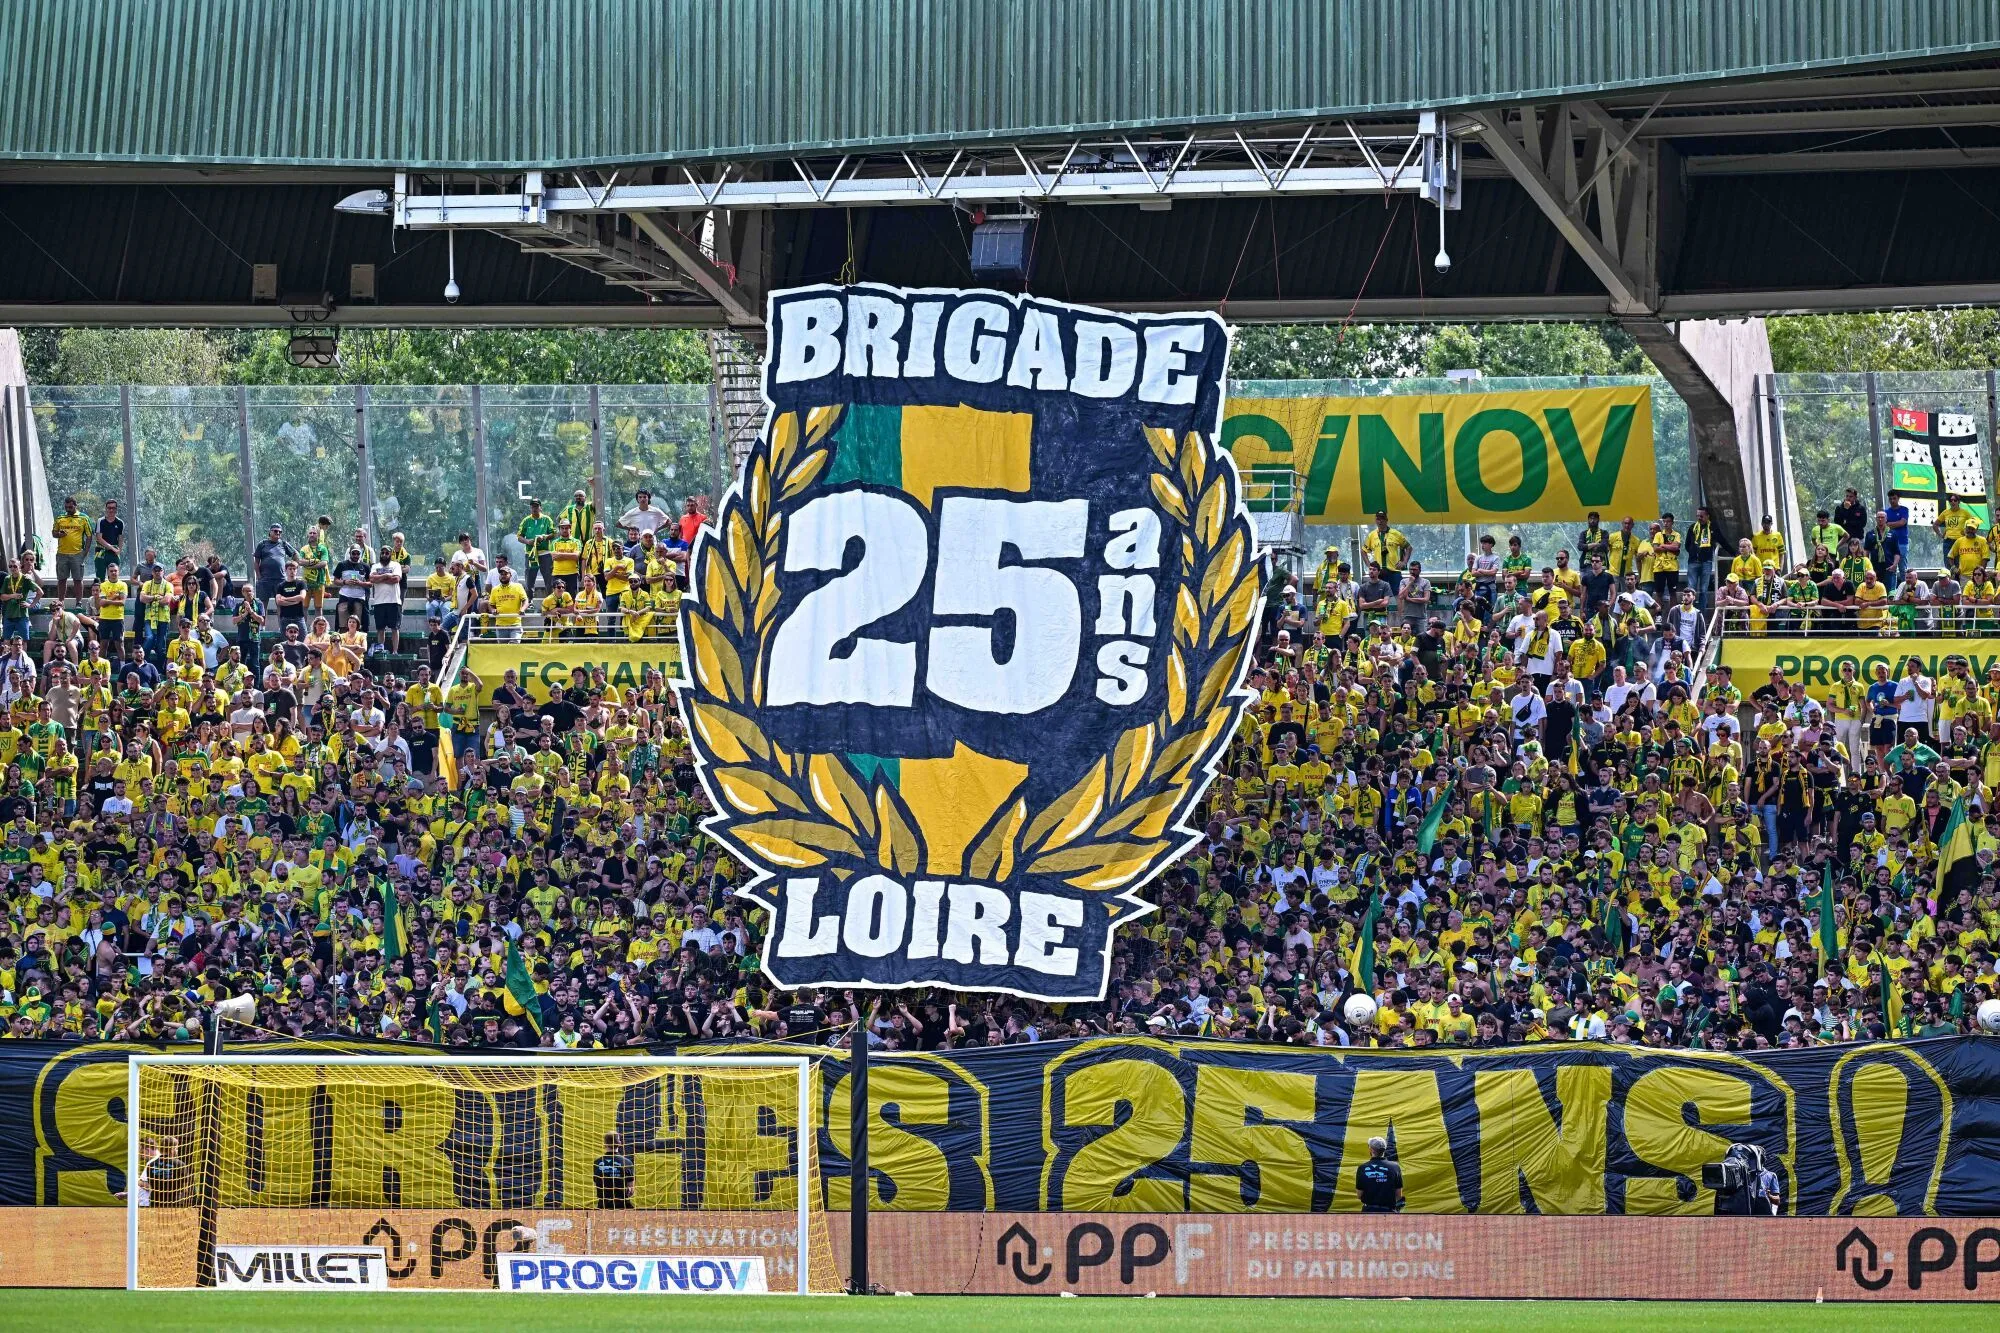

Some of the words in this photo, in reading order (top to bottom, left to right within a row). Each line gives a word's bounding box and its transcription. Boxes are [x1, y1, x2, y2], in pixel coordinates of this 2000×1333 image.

[776, 294, 1204, 405] BRIGADE
[767, 490, 1089, 714] 25
[520, 661, 568, 689] FC
[777, 874, 1084, 976] LOIRE
[217, 1252, 382, 1284] MILLET
[1065, 1222, 1213, 1285] PPF
[1247, 1229, 1445, 1252] PRÉSERVATION
[1247, 1259, 1282, 1280] DU
[1293, 1259, 1456, 1281] PATRIMOINE
